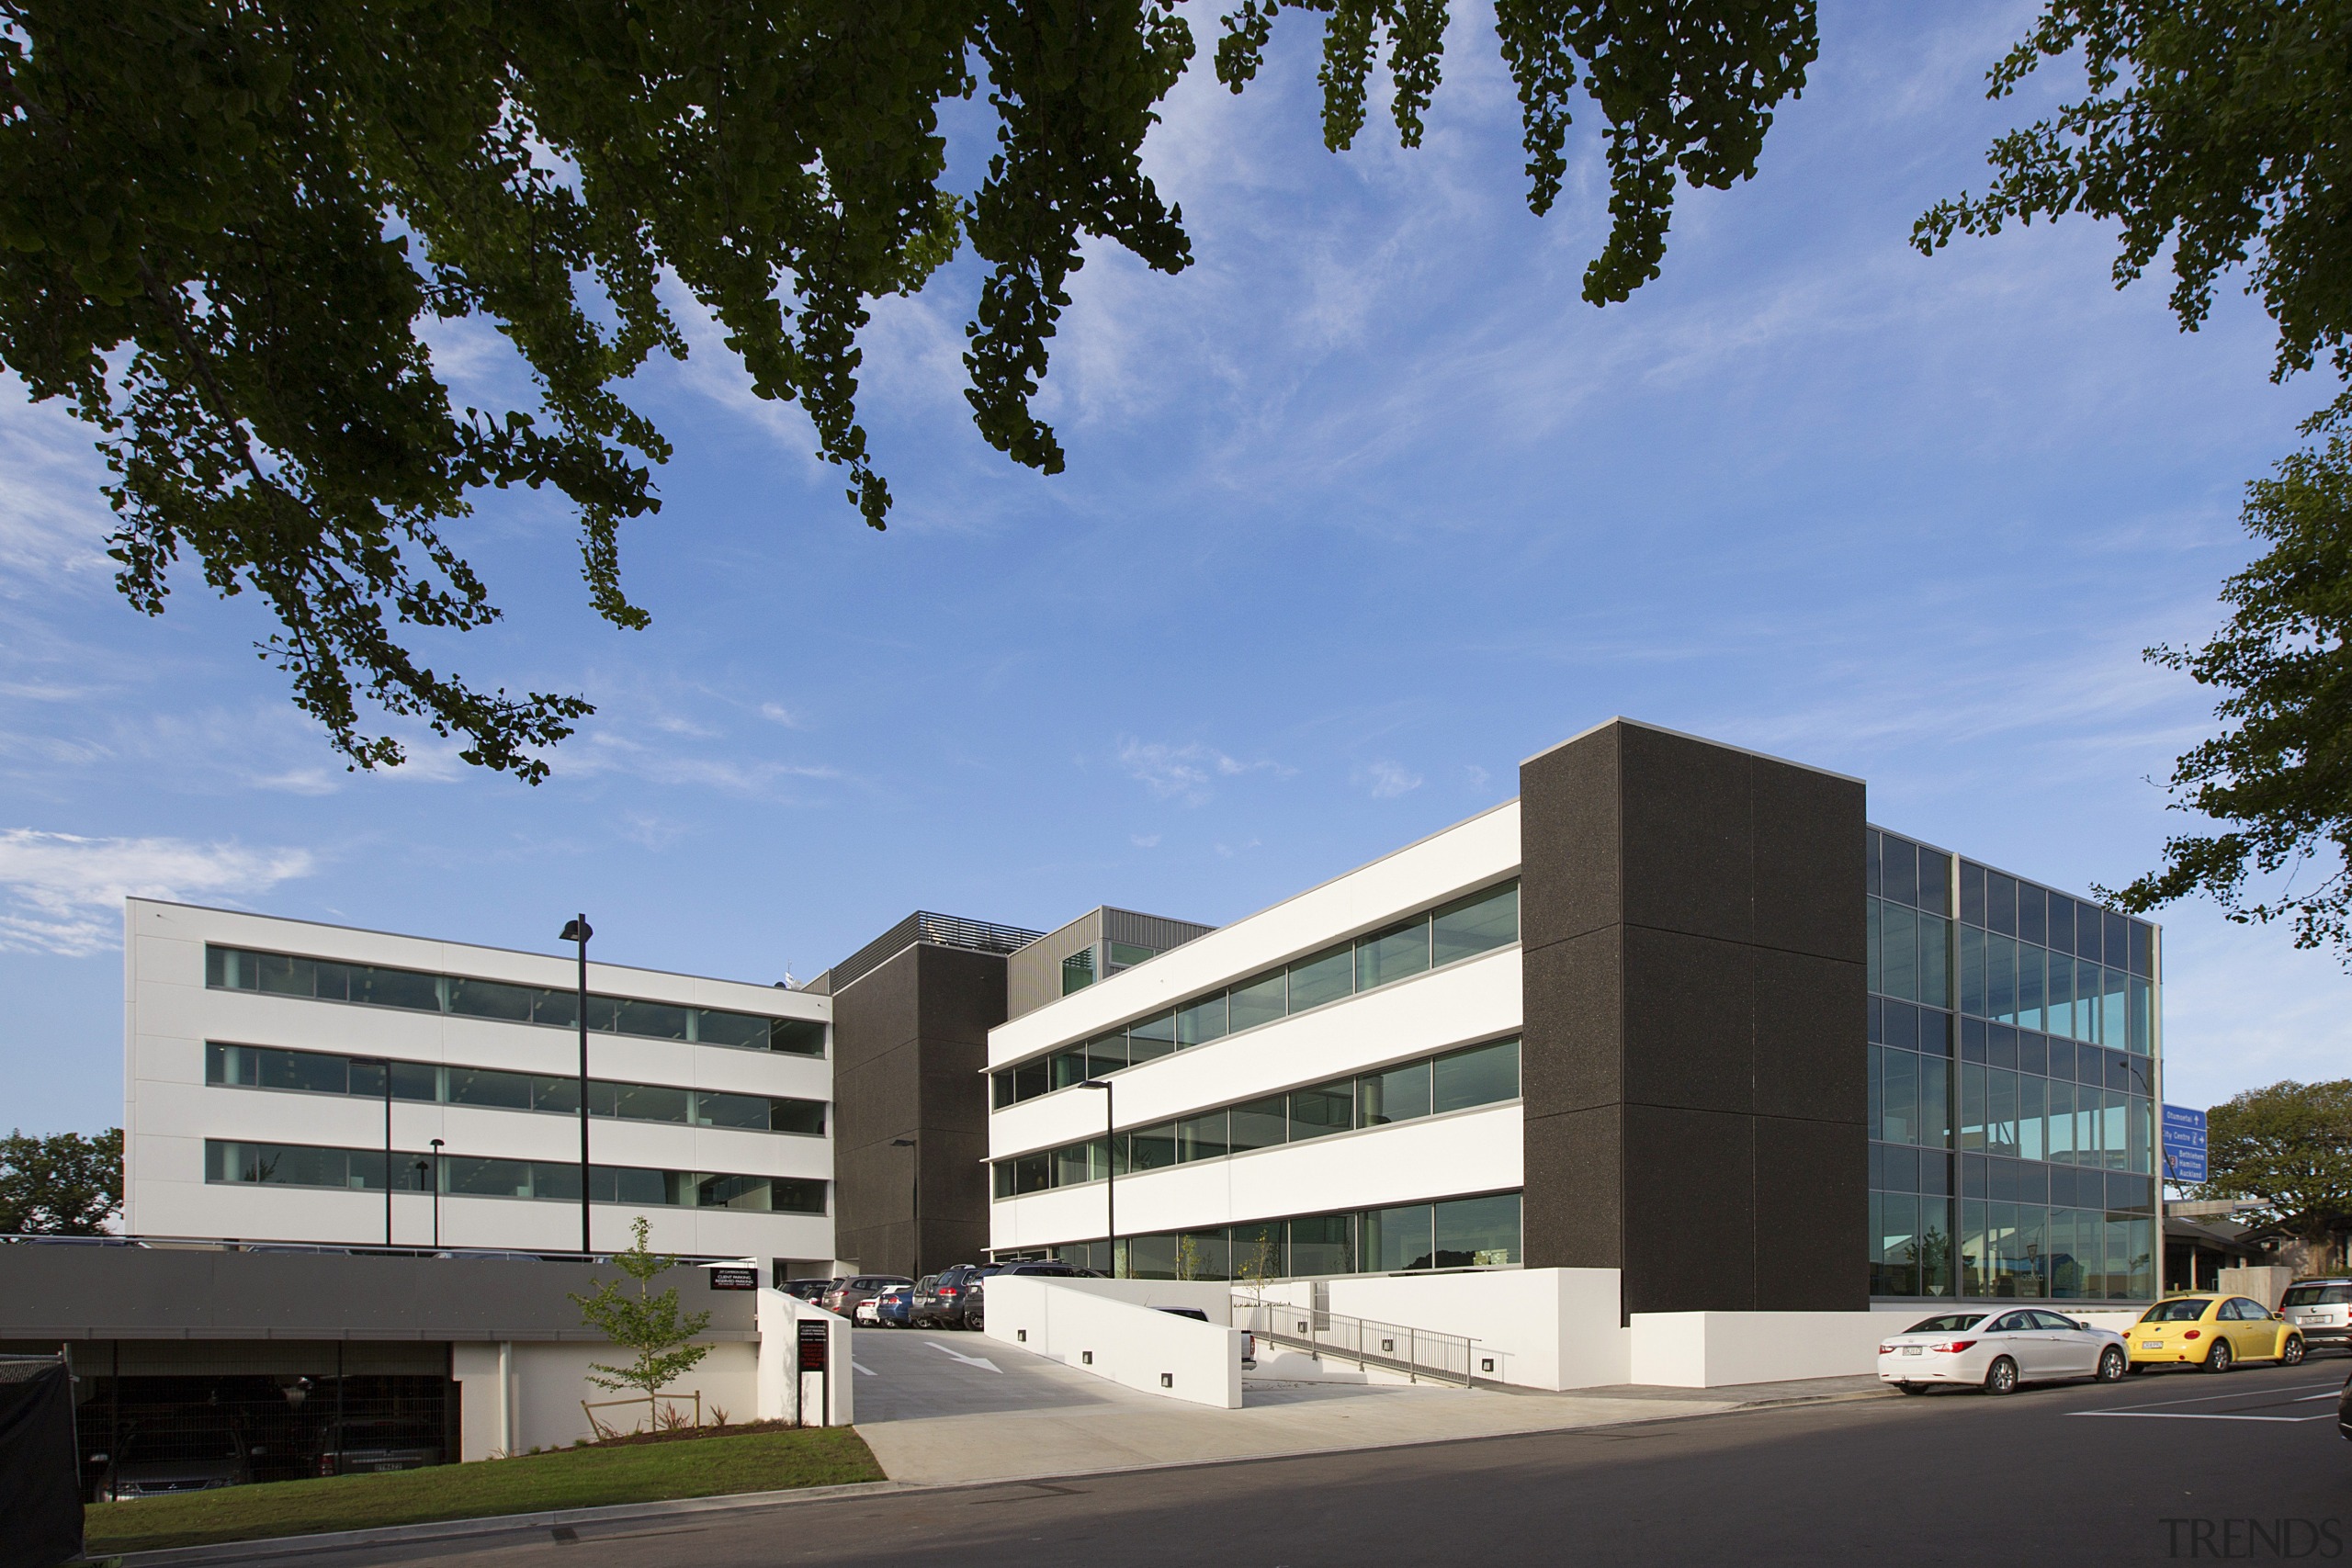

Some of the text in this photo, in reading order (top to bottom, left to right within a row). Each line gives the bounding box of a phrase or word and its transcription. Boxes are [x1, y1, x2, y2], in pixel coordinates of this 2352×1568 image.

[2166, 1111, 2192, 1122] Otumoetai
[2174, 1132, 2190, 1142] Centre
[2178, 1150, 2204, 1160] Bethlehem
[2179, 1159, 2201, 1168] Hamilton
[2179, 1169, 2202, 1179] Auckland
